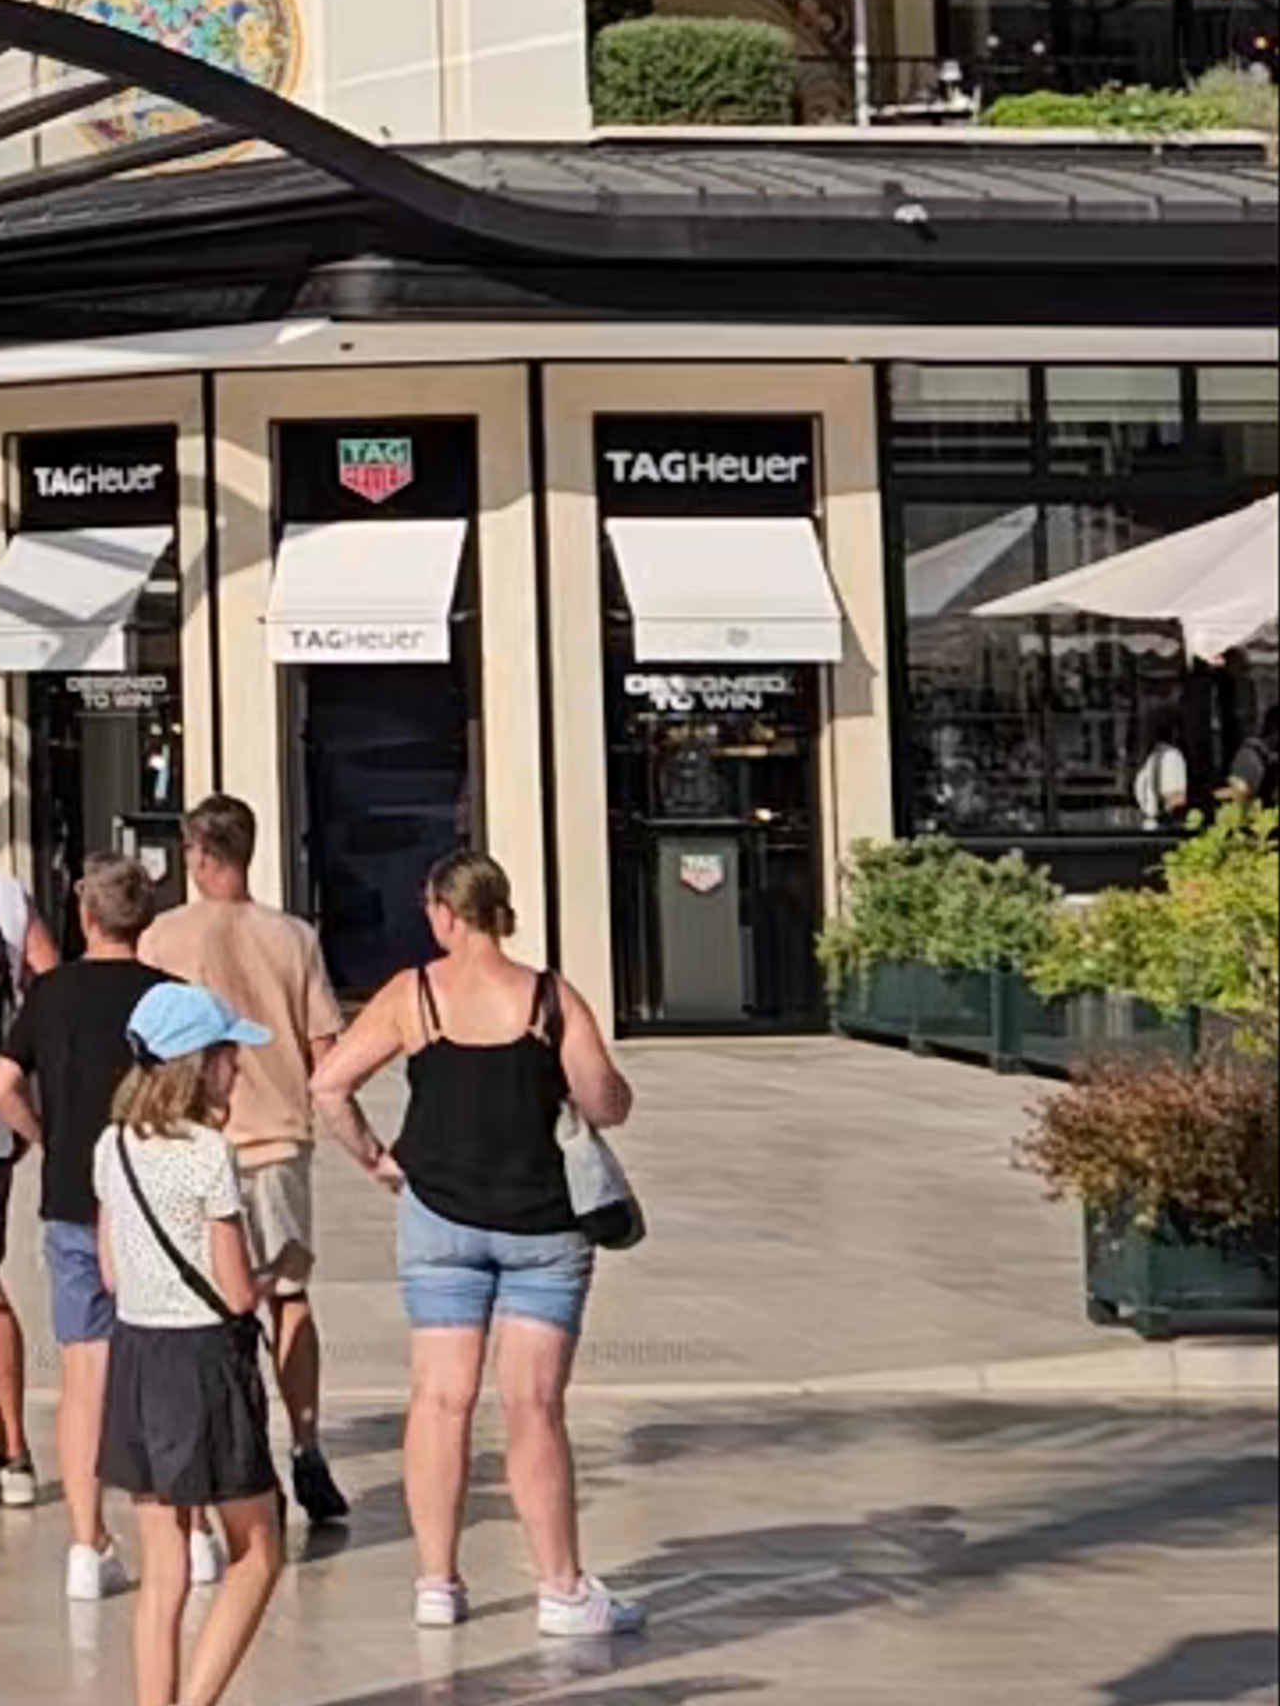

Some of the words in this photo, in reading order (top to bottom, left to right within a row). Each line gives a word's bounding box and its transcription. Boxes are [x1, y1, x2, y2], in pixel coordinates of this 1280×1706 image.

[623, 674, 788, 695] DESIGNED
[80, 692, 111, 708] TO
[112, 692, 153, 708] WIN
[649, 694, 695, 711] TO
[701, 693, 764, 711] WIN
